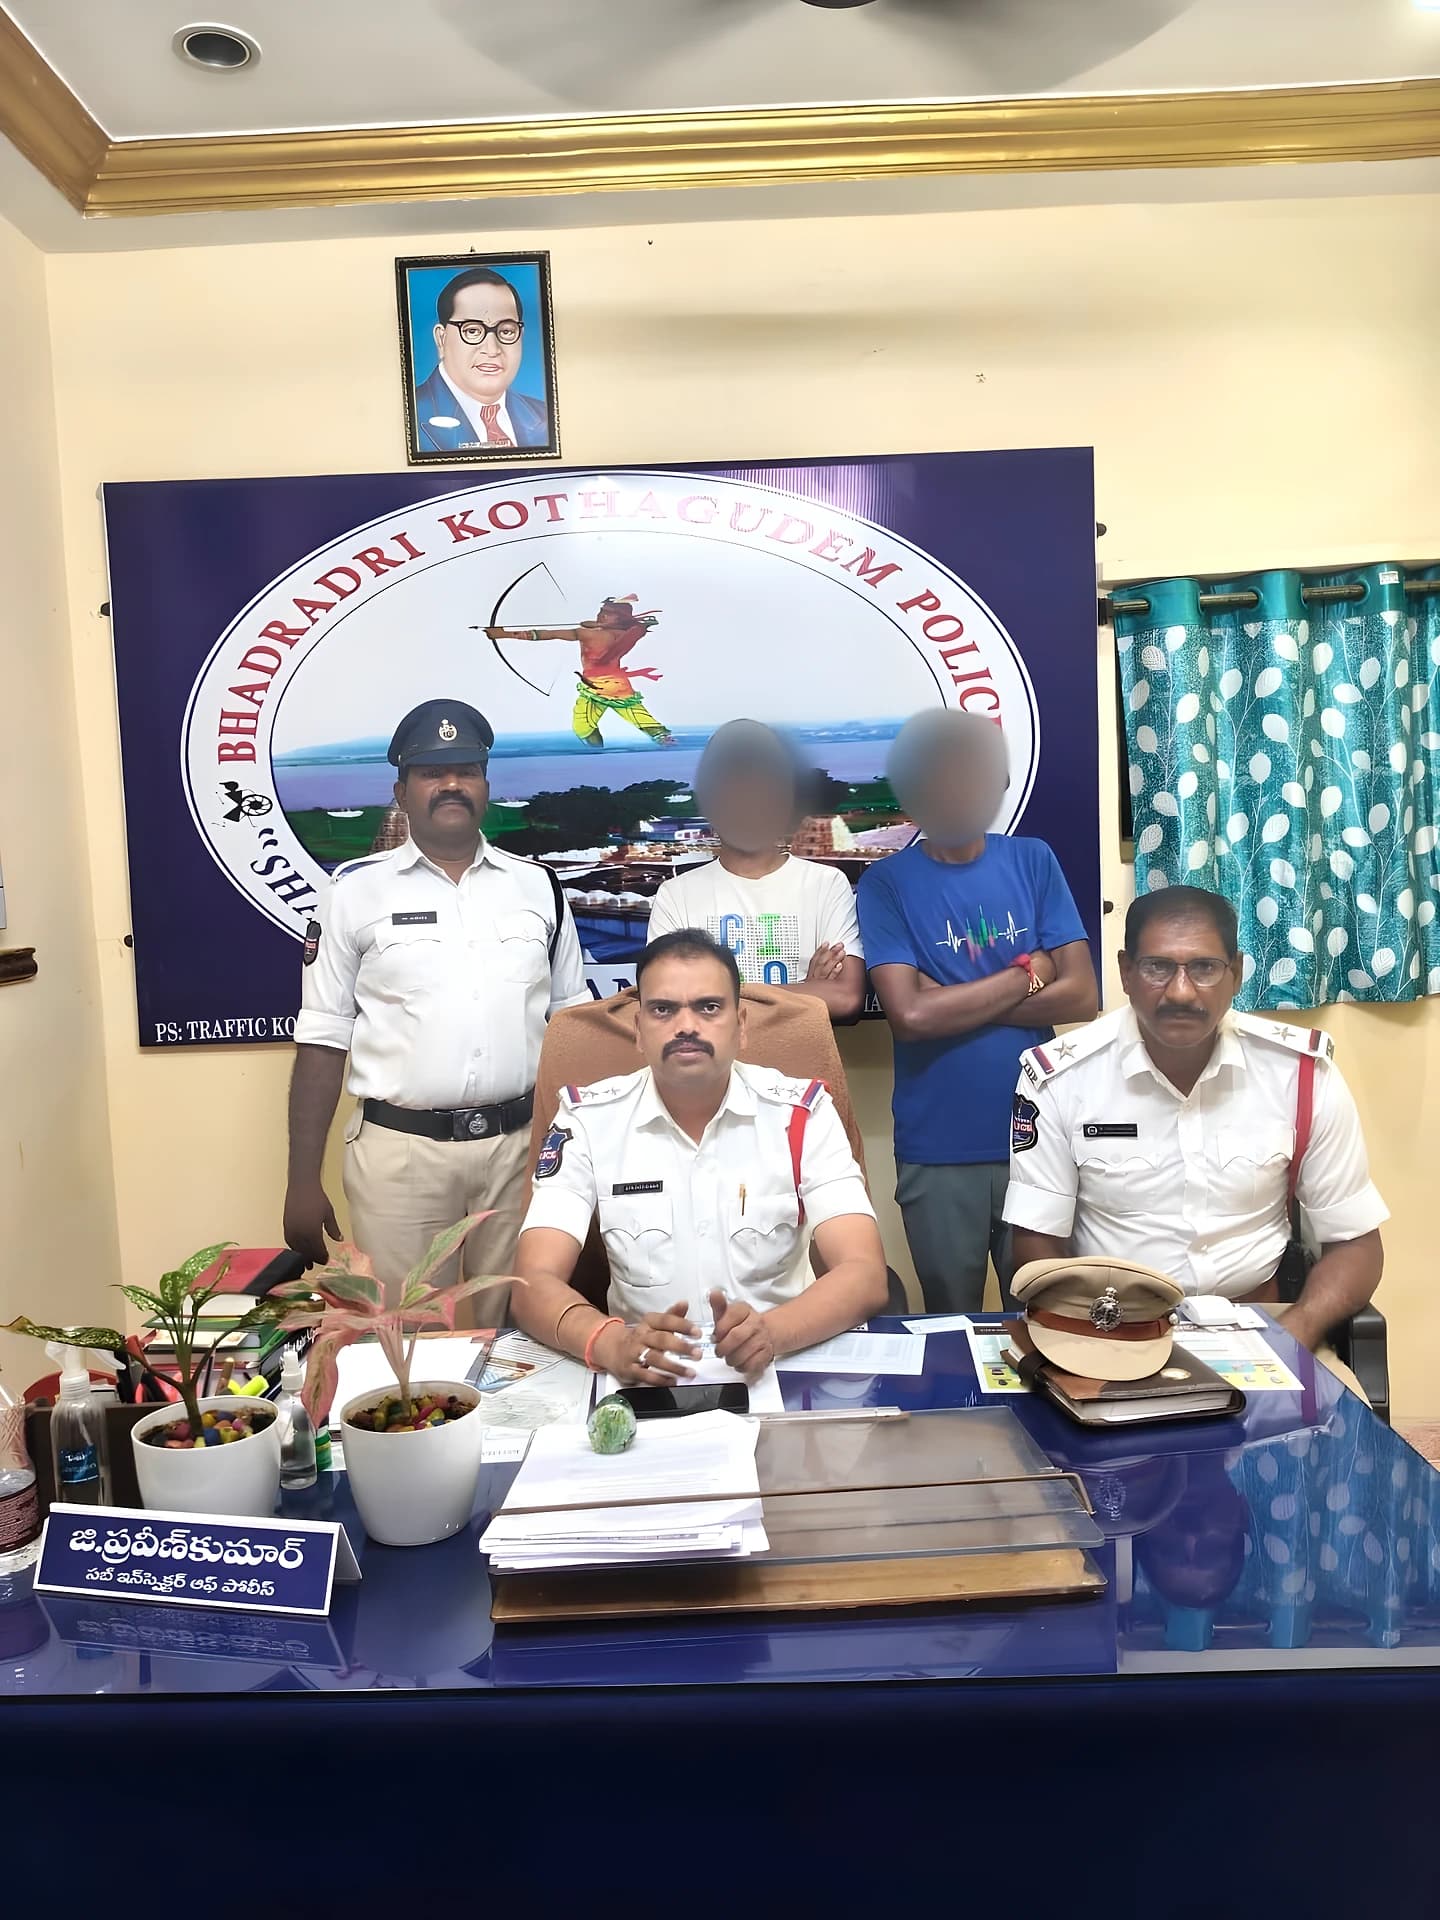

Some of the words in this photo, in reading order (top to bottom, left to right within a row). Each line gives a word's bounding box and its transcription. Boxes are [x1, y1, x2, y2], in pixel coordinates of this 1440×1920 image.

[217, 531, 426, 766] BHADRADRI
[437, 490, 904, 590] KOTHAGUDEM
[895, 588, 1005, 736] POLIC
[154, 1022, 183, 1042] PS:
[186, 1017, 267, 1040] TRAFFIC
[190, 1575, 219, 1595] ఆఫ్
[221, 1578, 275, 1597] పోలీస్
